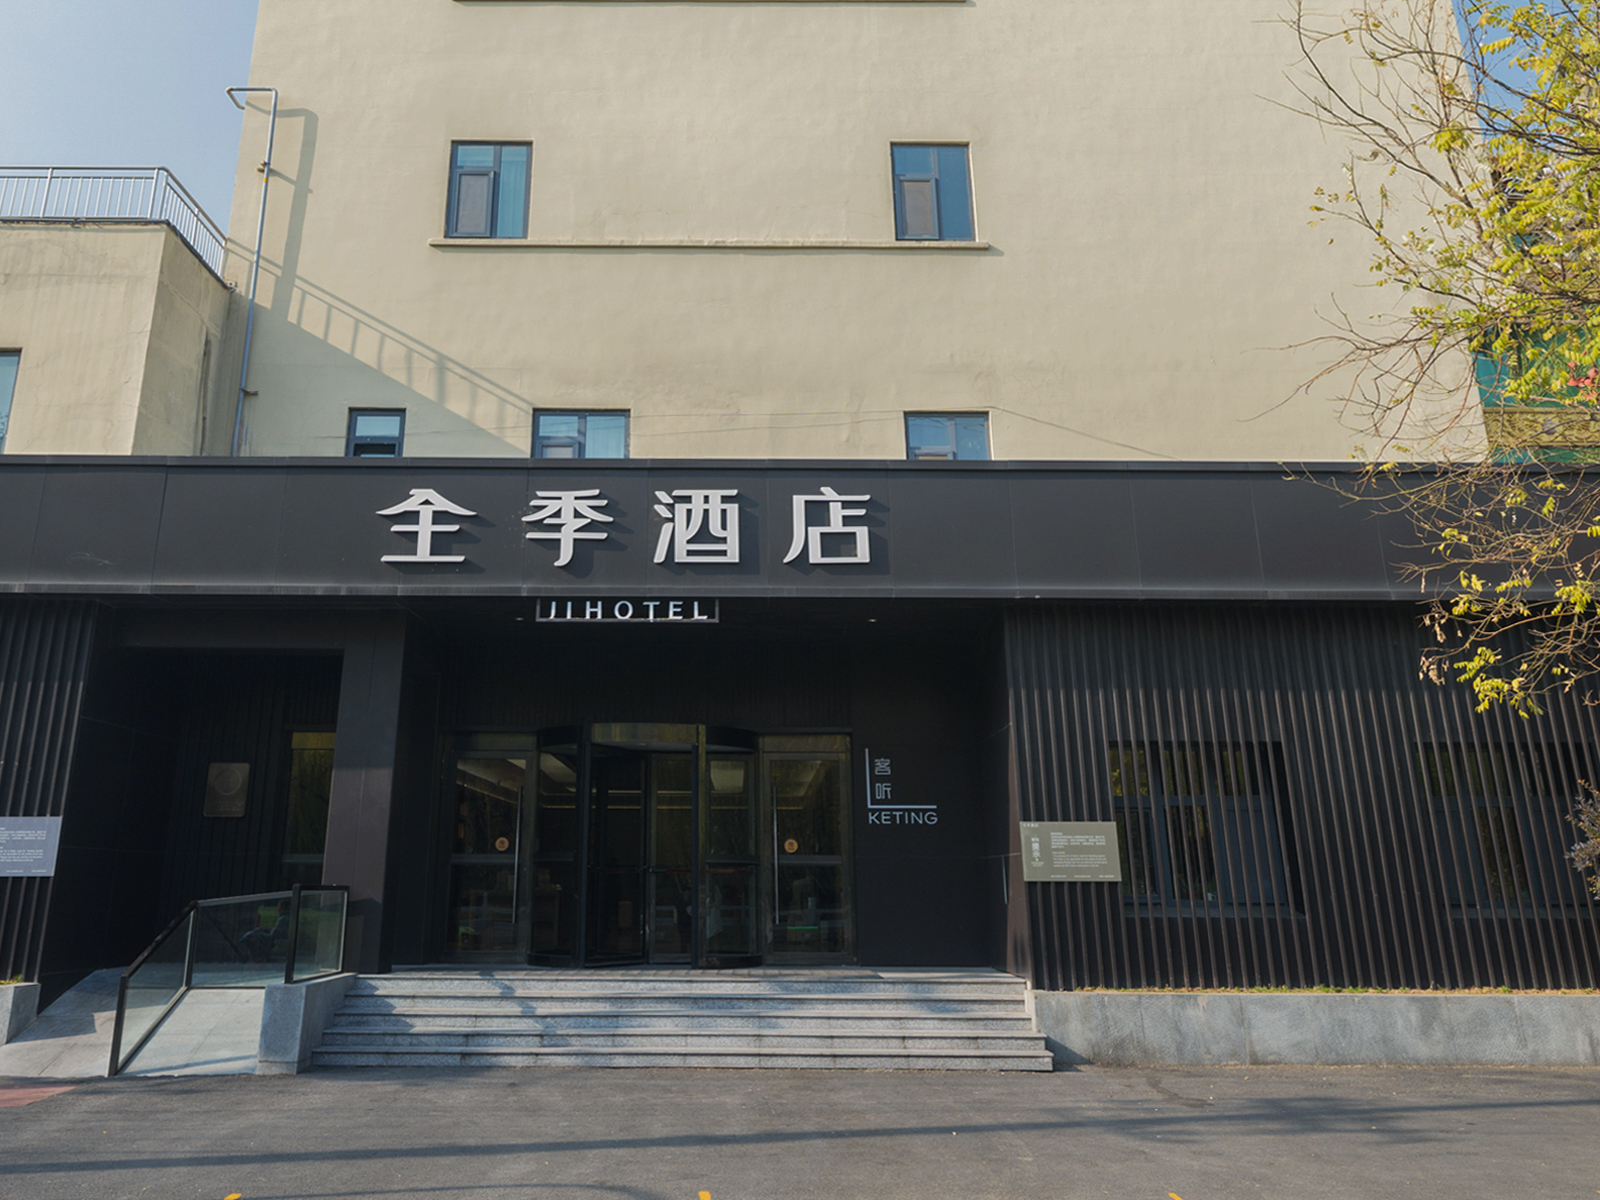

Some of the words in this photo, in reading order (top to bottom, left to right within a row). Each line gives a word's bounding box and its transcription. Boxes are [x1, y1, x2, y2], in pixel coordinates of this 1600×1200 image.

[375, 487, 872, 567] 全季酒店
[868, 812, 939, 825] KETING
